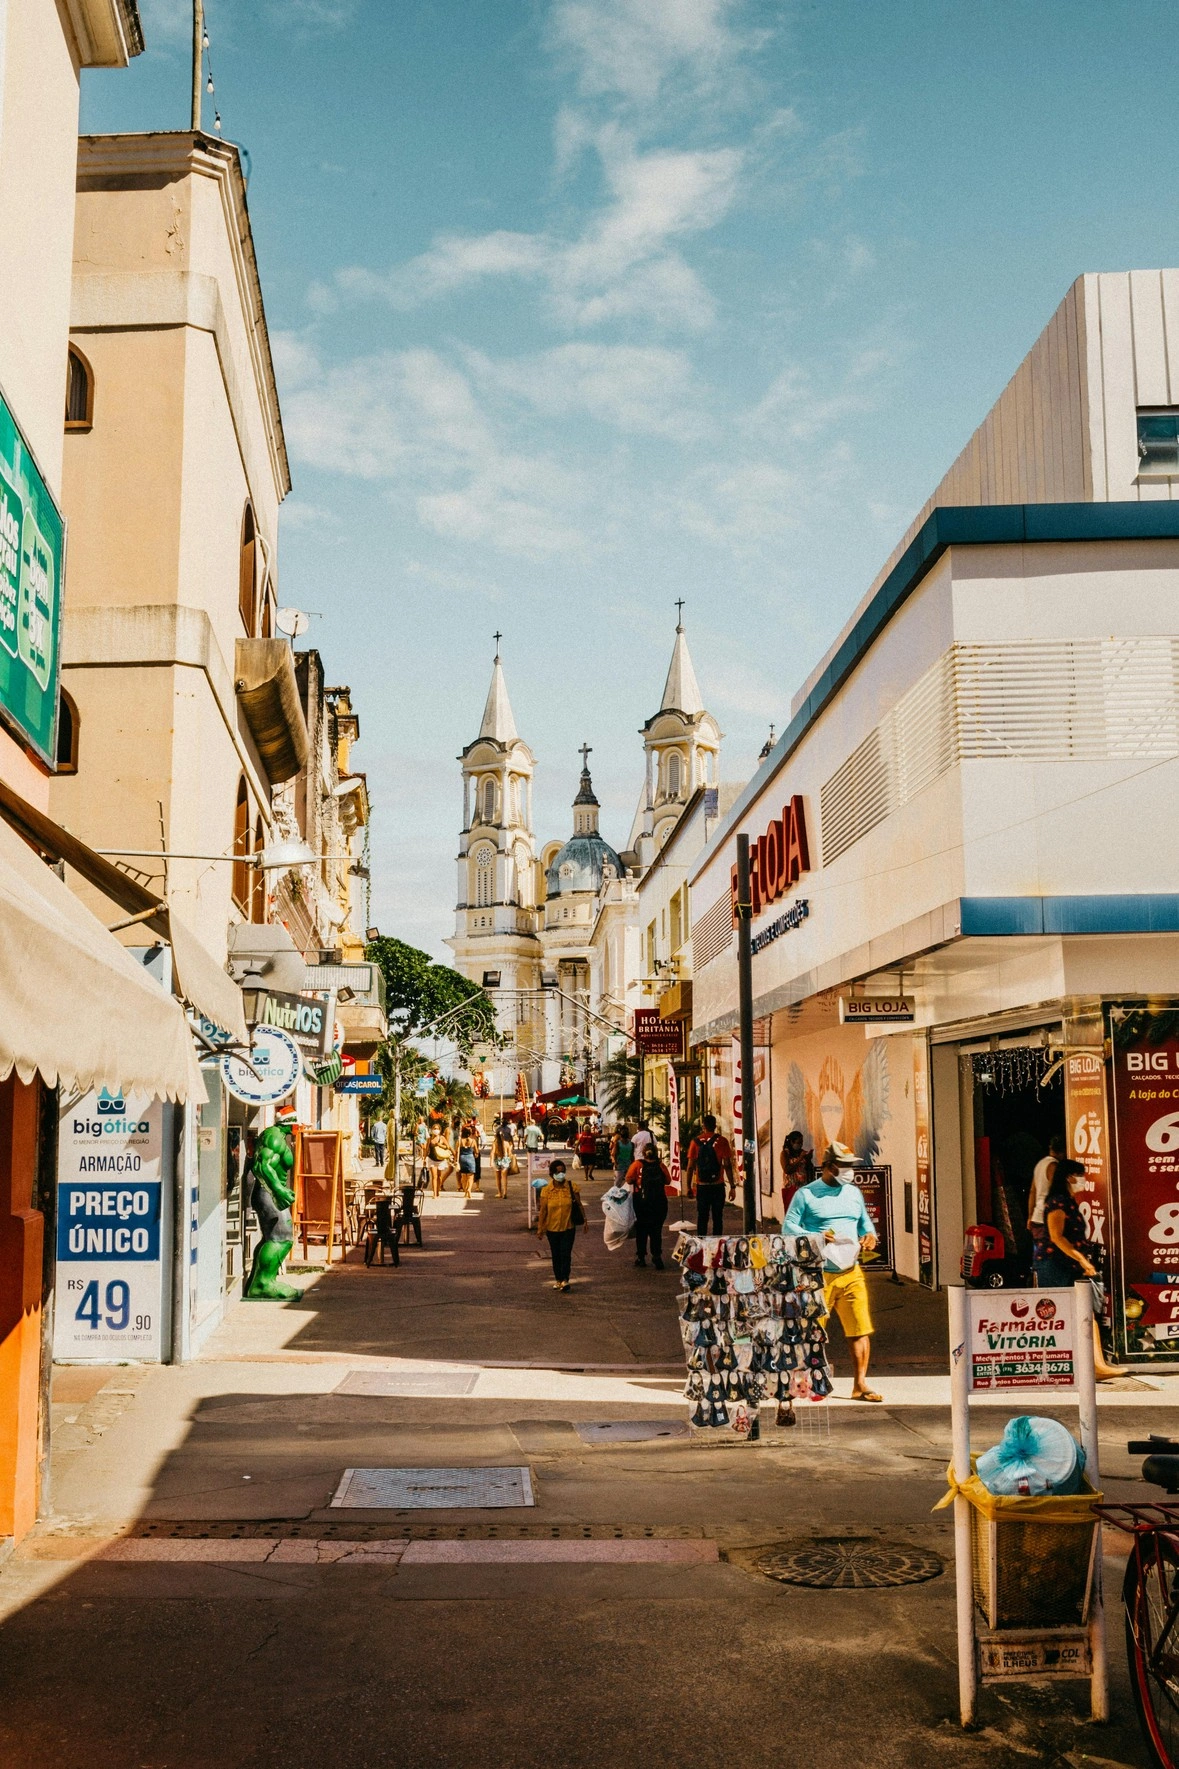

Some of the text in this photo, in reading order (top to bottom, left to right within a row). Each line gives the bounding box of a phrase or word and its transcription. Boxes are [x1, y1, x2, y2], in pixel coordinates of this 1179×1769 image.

[757, 795, 811, 906] LOJA
[848, 1002, 909, 1013] BIG LOJA
[638, 1025, 680, 1033] BRITÂNIA
[1069, 1058, 1101, 1074] BIG LOJA
[1126, 1052, 1169, 1071] BIG
[238, 1065, 284, 1078] bigótica
[1129, 1090, 1136, 1099] A
[1138, 1090, 1157, 1101] loja
[1158, 1089, 1171, 1099] do
[73, 1118, 150, 1137] bigótica
[79, 1153, 142, 1175] ARMAÇÃO
[1148, 1156, 1176, 1164] sem
[852, 1174, 880, 1185] OJA
[70, 1190, 150, 1220] PREÇO
[69, 1224, 149, 1253] ÚNICO
[67, 1279, 84, 1290] R$
[978, 1317, 1065, 1334] Farmácia
[987, 1333, 1056, 1350] VITÓRIA
[1032, 1352, 1070, 1360] Perumaria
[1062, 1648, 1080, 1659] CDL
